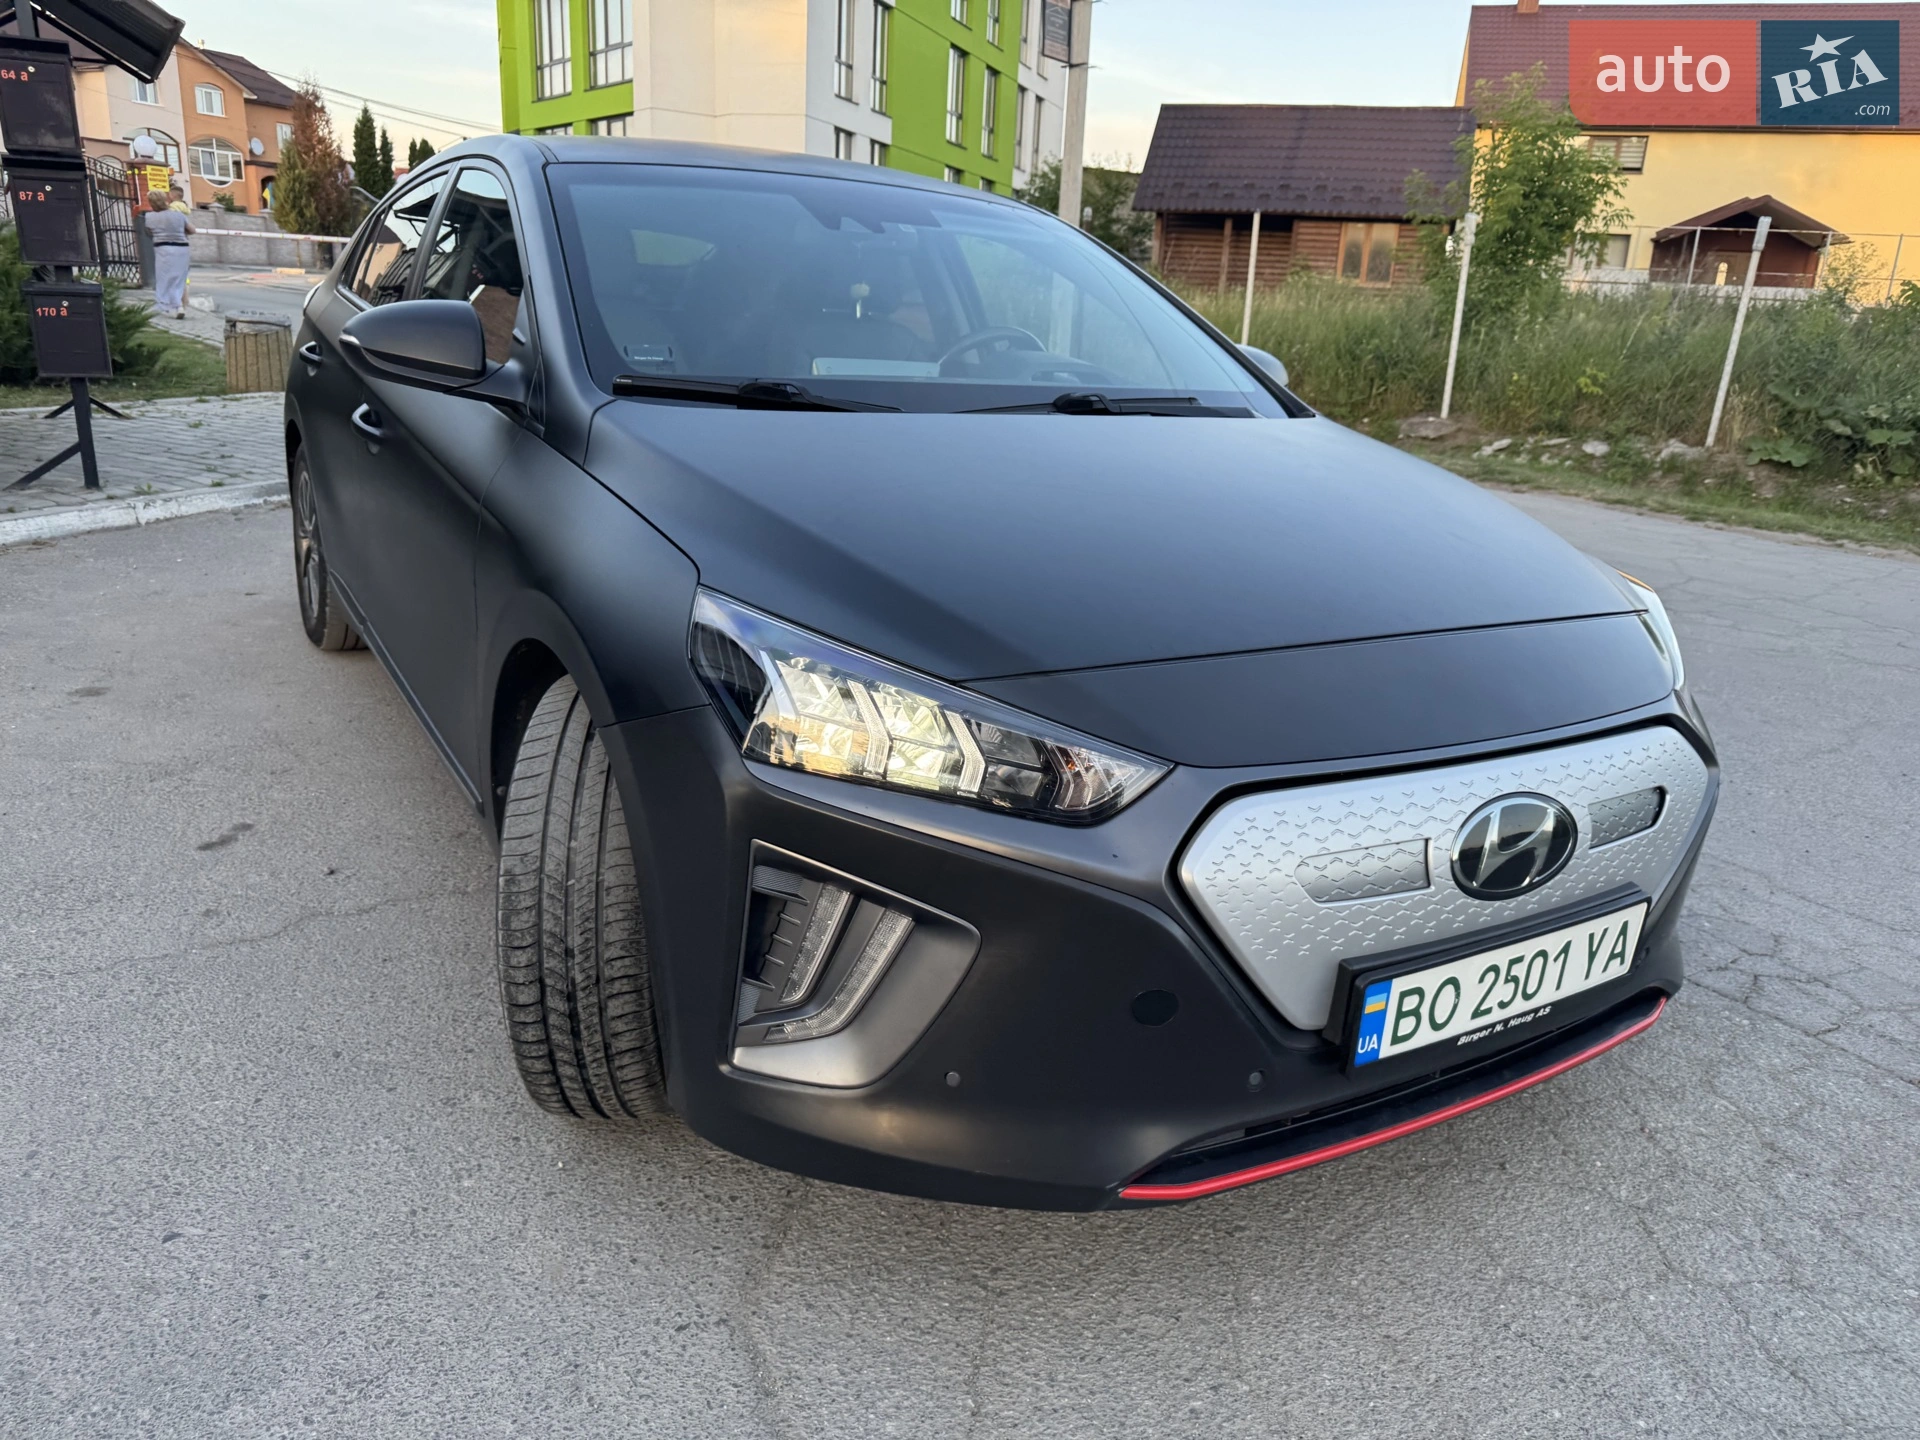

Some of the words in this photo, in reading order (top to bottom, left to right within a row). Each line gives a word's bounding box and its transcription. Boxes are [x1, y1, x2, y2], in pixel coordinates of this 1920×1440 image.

[1, 69, 16, 80] 64
[19, 191, 33, 201] 87
[36, 307, 57, 317] 170
[1389, 976, 1462, 1047] BO
[1470, 939, 1572, 1021] 2501
[1584, 919, 1629, 981] YA
[1456, 1027, 1493, 1046] Birger
[1507, 1012, 1535, 1029] Haug
[1535, 1005, 1552, 1018] AS
[1357, 1033, 1379, 1054] UA
